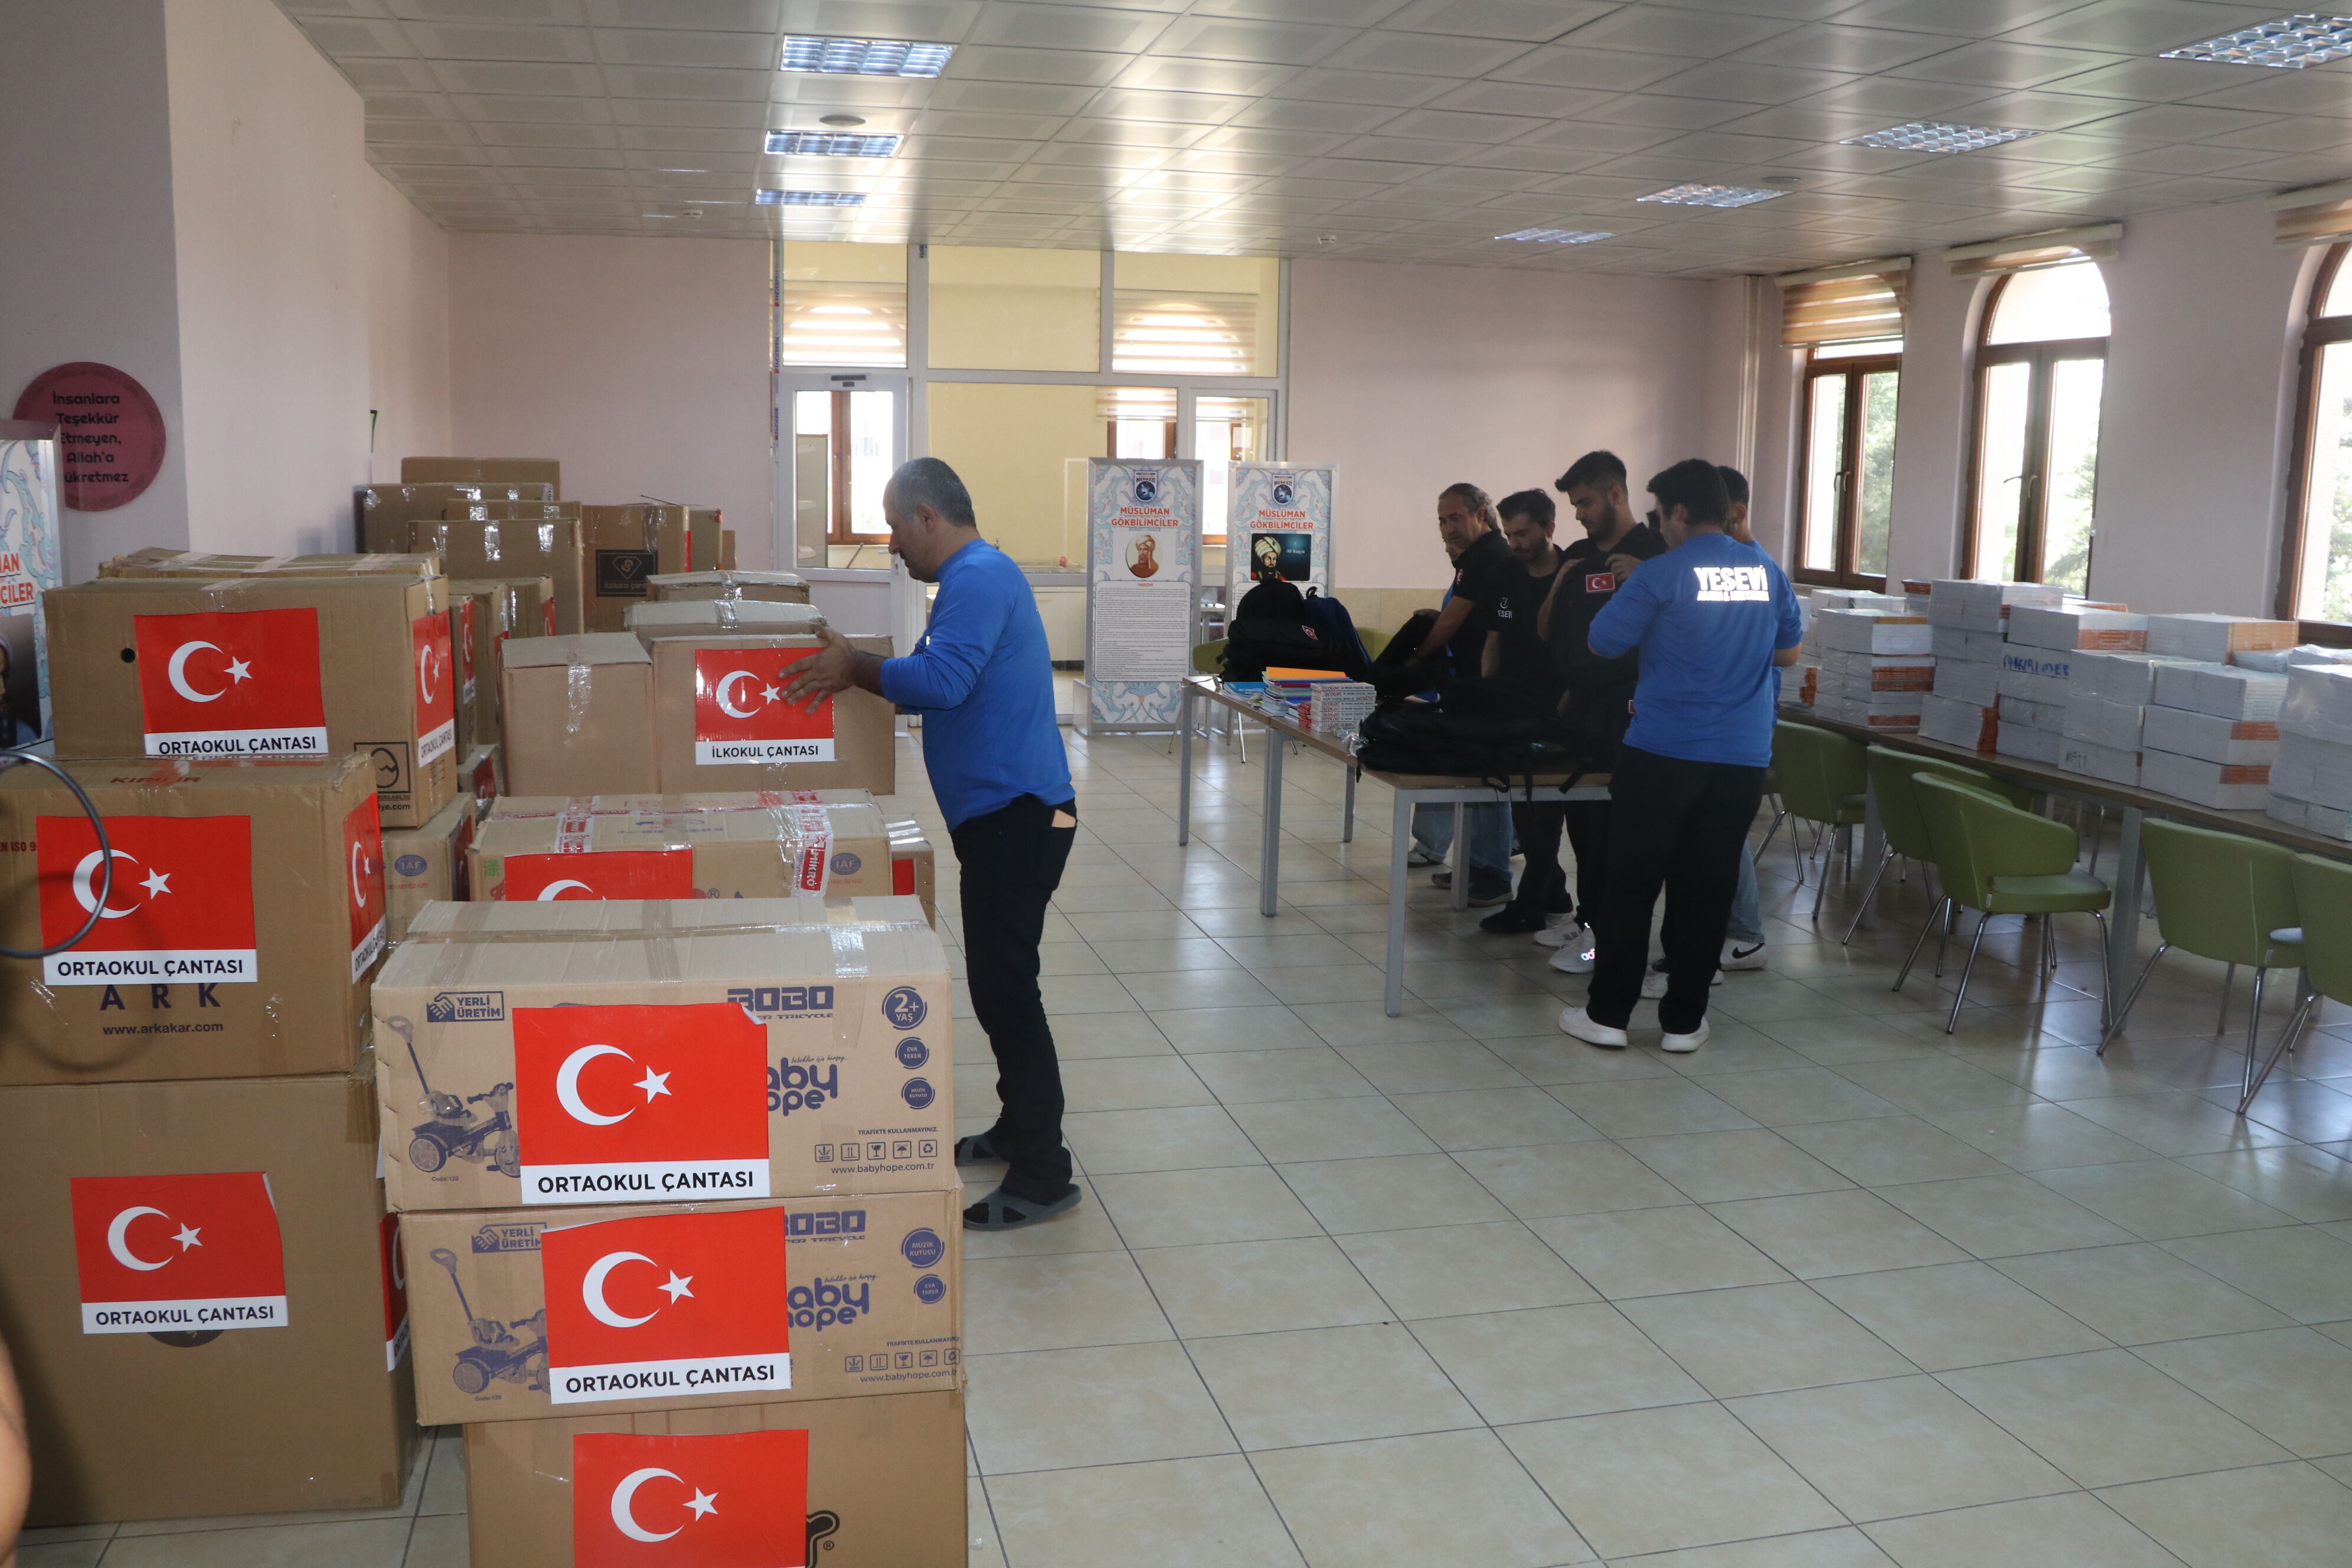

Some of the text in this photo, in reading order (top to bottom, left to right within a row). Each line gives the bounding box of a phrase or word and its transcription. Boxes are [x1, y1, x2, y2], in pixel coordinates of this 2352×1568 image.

[53, 391, 120, 404] İnsanlara
[57, 413, 119, 426] Teşekkür
[67, 452, 115, 463] Allah'a
[65, 473, 129, 482] ükretmez
[1121, 506, 1170, 515] MÜSLÜMAN
[1259, 509, 1305, 518] MÜSLÜMAN
[1111, 517, 1178, 527] GÖKBİLİMCİLER
[1250, 520, 1314, 529] GÖKBİLİMCİLER
[159, 736, 316, 754] ORTAOKUL ÇANTASI
[712, 746, 818, 758] İLKOKUL ÇANTASI
[11, 842, 27, 852] ISO
[401, 861, 420, 870] IAF
[806, 851, 820, 887] MİKRO
[836, 860, 855, 869] IAF
[58, 959, 243, 976] ORTAOKUL ÇANTASI
[457, 995, 490, 1006] YERLİ
[894, 994, 919, 1013] 2+
[457, 1007, 500, 1018] ÜRETİM
[896, 1013, 913, 1023] YAŞ
[103, 1023, 224, 1035] www.arkakar.com
[767, 1090, 825, 1116] ope
[831, 1162, 935, 1174] www.babyhope.com.tr
[538, 1171, 753, 1194] ORTAOKUL ÇANTASI
[785, 1210, 866, 1236] OBO
[501, 1227, 534, 1237] YERLİ
[788, 1277, 870, 1314] aby
[96, 1305, 274, 1326] ORTAOKUL ÇANTASI
[566, 1371, 680, 1393] ORTAOKUL
[686, 1365, 774, 1387] ÇANTASI
[860, 1370, 958, 1383] www.babyhope.com.tr
